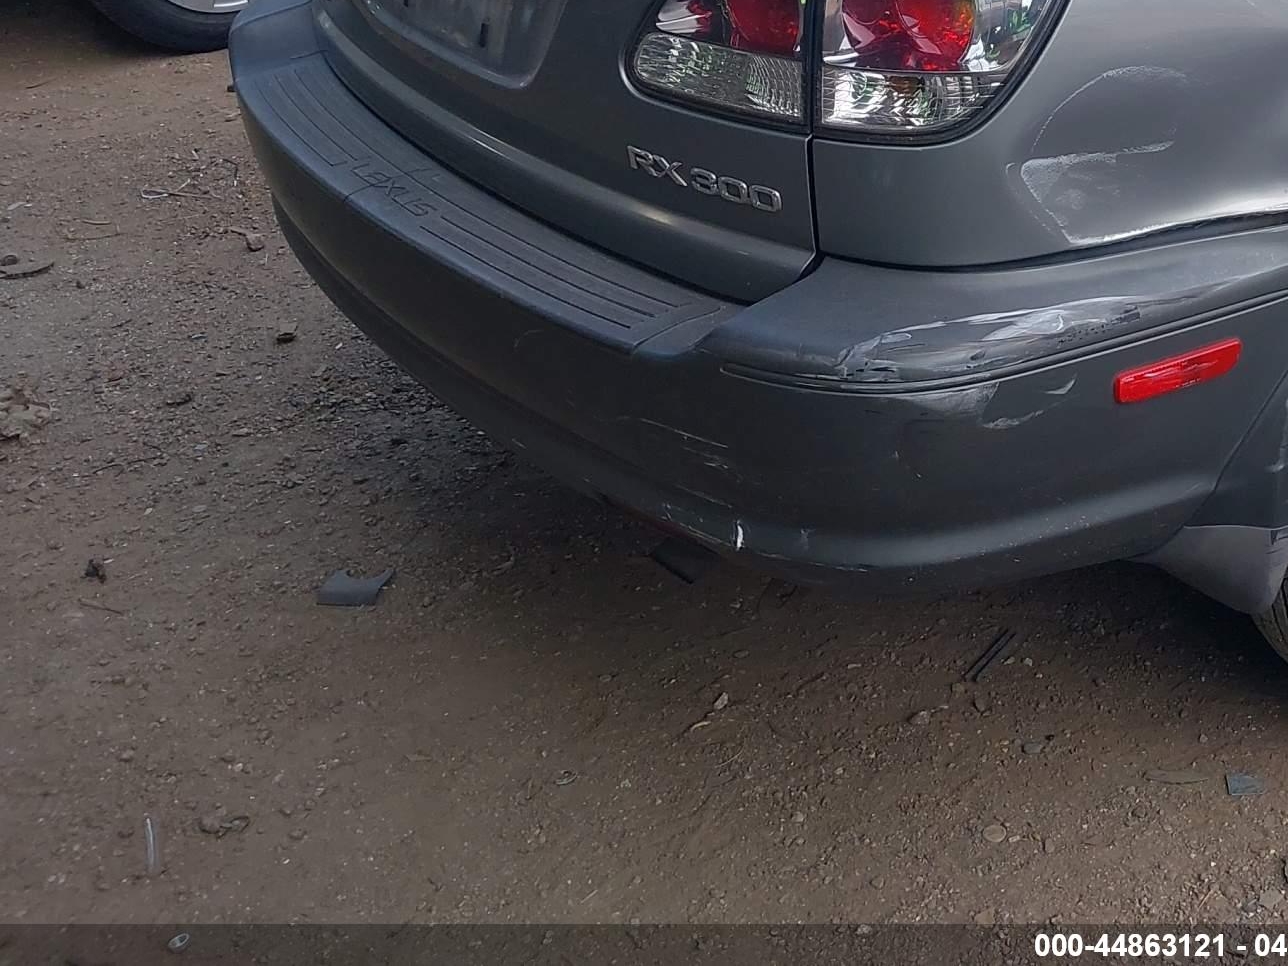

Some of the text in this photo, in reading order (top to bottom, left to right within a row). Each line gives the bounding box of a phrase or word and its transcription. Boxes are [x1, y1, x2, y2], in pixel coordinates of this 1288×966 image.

[349, 162, 440, 217] LEXUS
[625, 144, 784, 213] RX 300
